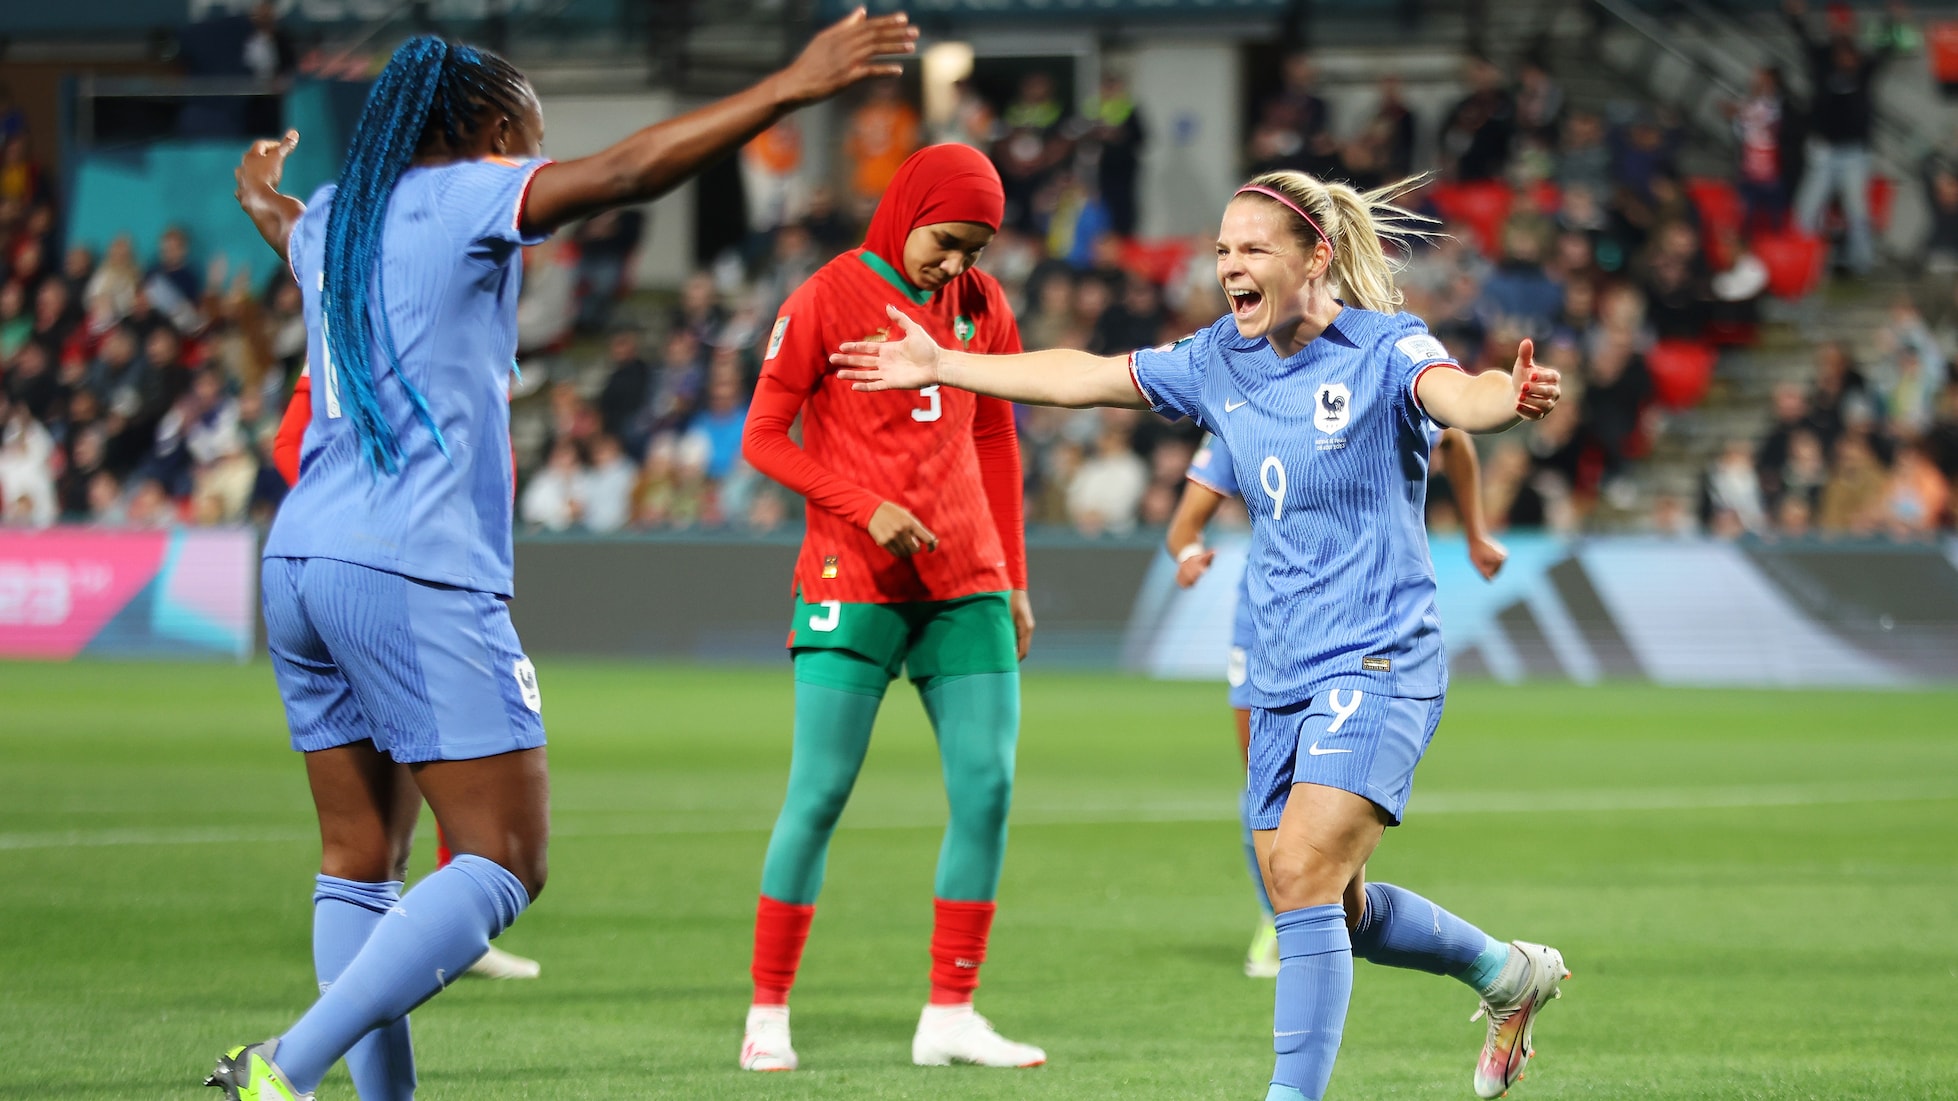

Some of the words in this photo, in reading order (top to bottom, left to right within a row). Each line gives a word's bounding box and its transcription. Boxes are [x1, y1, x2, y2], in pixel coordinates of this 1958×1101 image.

[911, 384, 942, 422] 3
[1260, 456, 1286, 520] 9
[1327, 688, 1363, 733] 9
